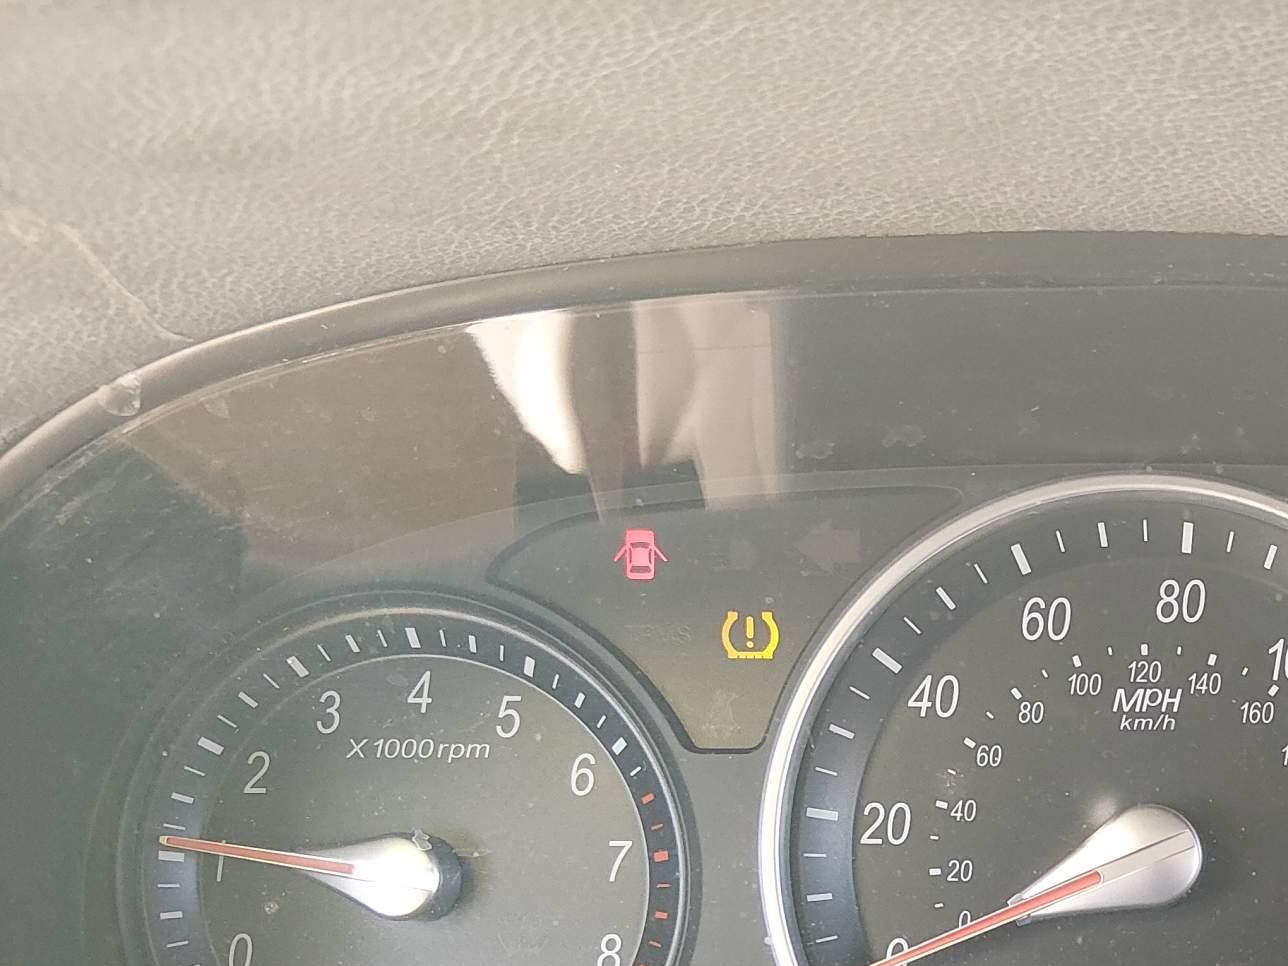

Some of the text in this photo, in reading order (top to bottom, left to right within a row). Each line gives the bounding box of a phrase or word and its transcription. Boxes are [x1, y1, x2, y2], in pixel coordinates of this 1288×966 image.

[1157, 580, 1205, 622] 80
[1022, 598, 1070, 640] 60
[1069, 674, 1101, 695] 100
[1129, 661, 1161, 682] 120
[1189, 673, 1221, 694] 140
[408, 671, 432, 713] 4
[908, 675, 958, 717] 40
[1113, 689, 1182, 712] MPH
[317, 691, 340, 733] 3
[496, 696, 521, 737] 5
[1019, 702, 1043, 723] 80
[1119, 714, 1176, 731] km/h
[1241, 702, 1273, 723] 160
[976, 744, 1002, 767] 60
[244, 752, 269, 793] 2
[571, 753, 595, 795] 6
[861, 803, 910, 844] 20
[951, 800, 976, 821] 40
[609, 841, 632, 881] 7
[947, 860, 972, 881] 20
